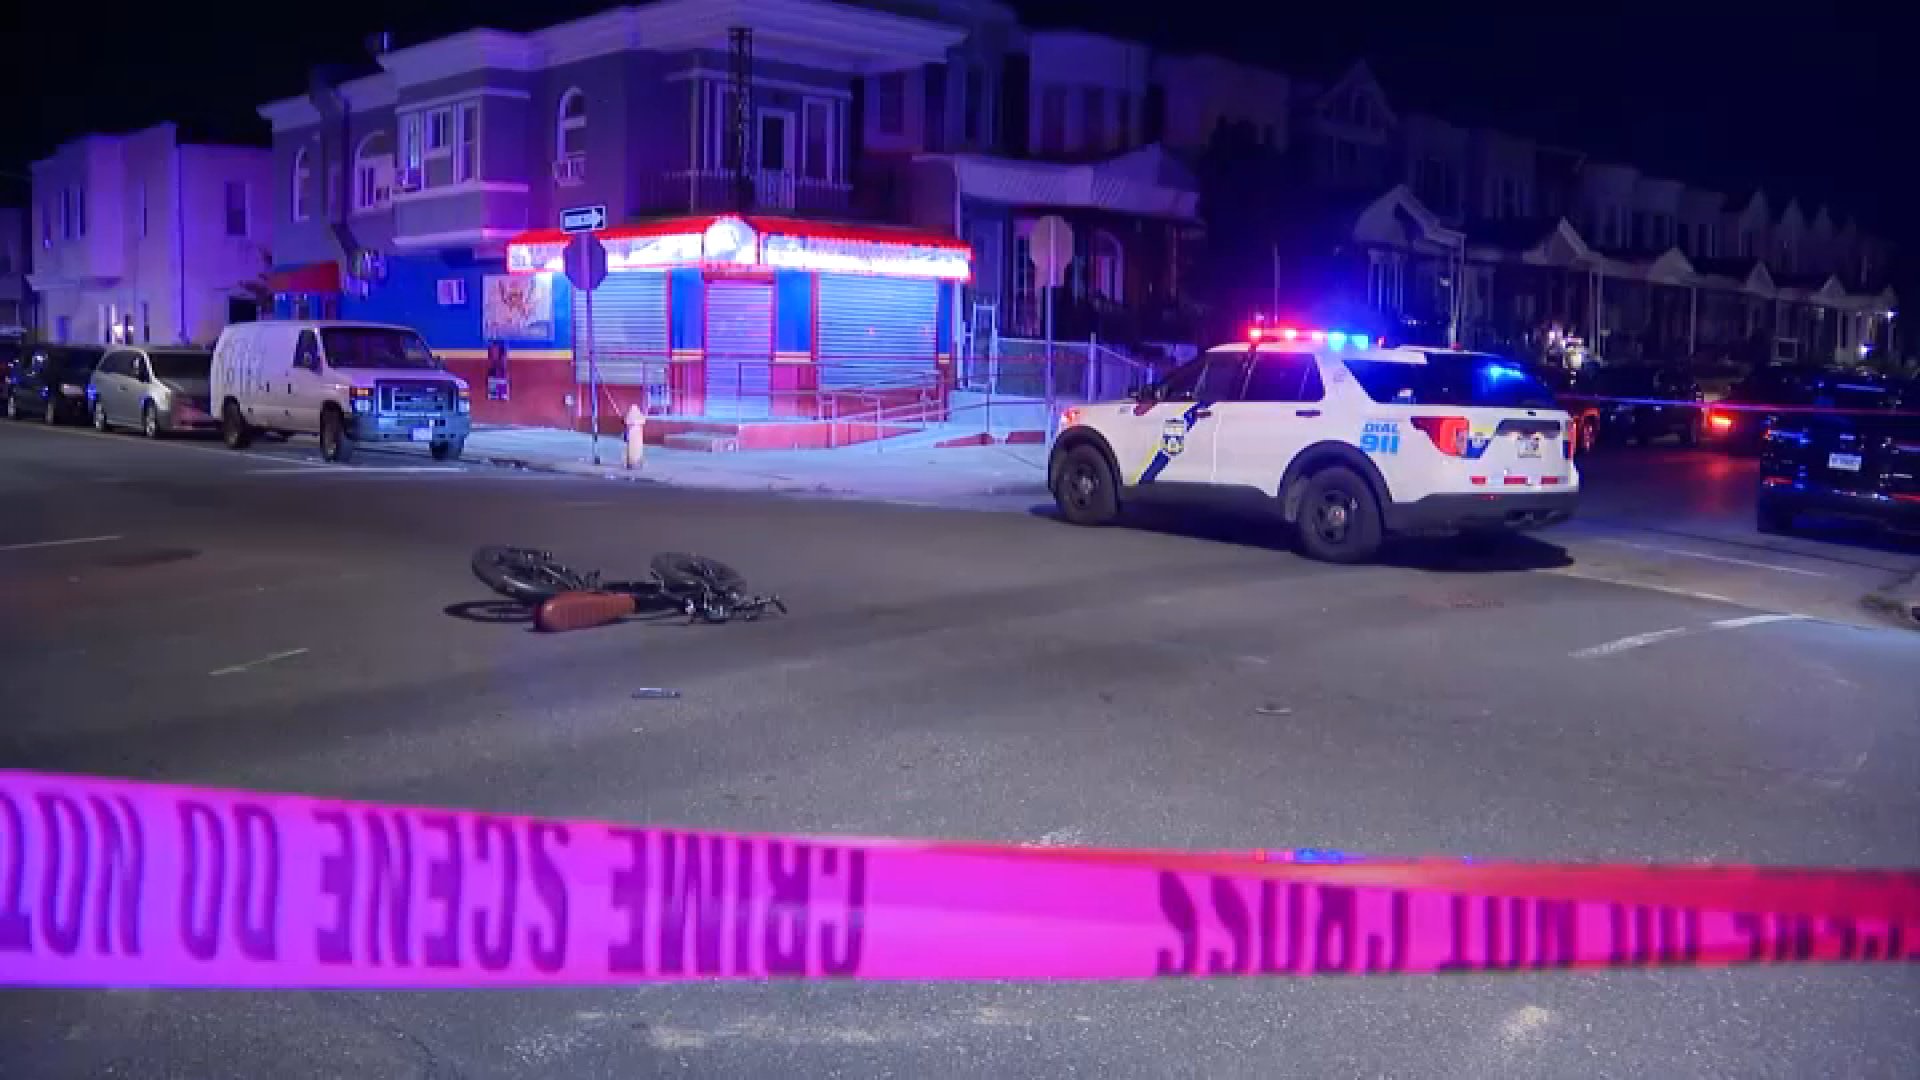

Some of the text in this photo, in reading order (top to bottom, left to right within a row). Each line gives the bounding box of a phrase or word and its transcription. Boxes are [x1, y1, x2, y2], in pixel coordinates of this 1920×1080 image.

[1360, 433, 1399, 454] 911
[177, 800, 279, 963] DO
[311, 807, 569, 974] SCENE
[607, 827, 865, 978] CRIME
